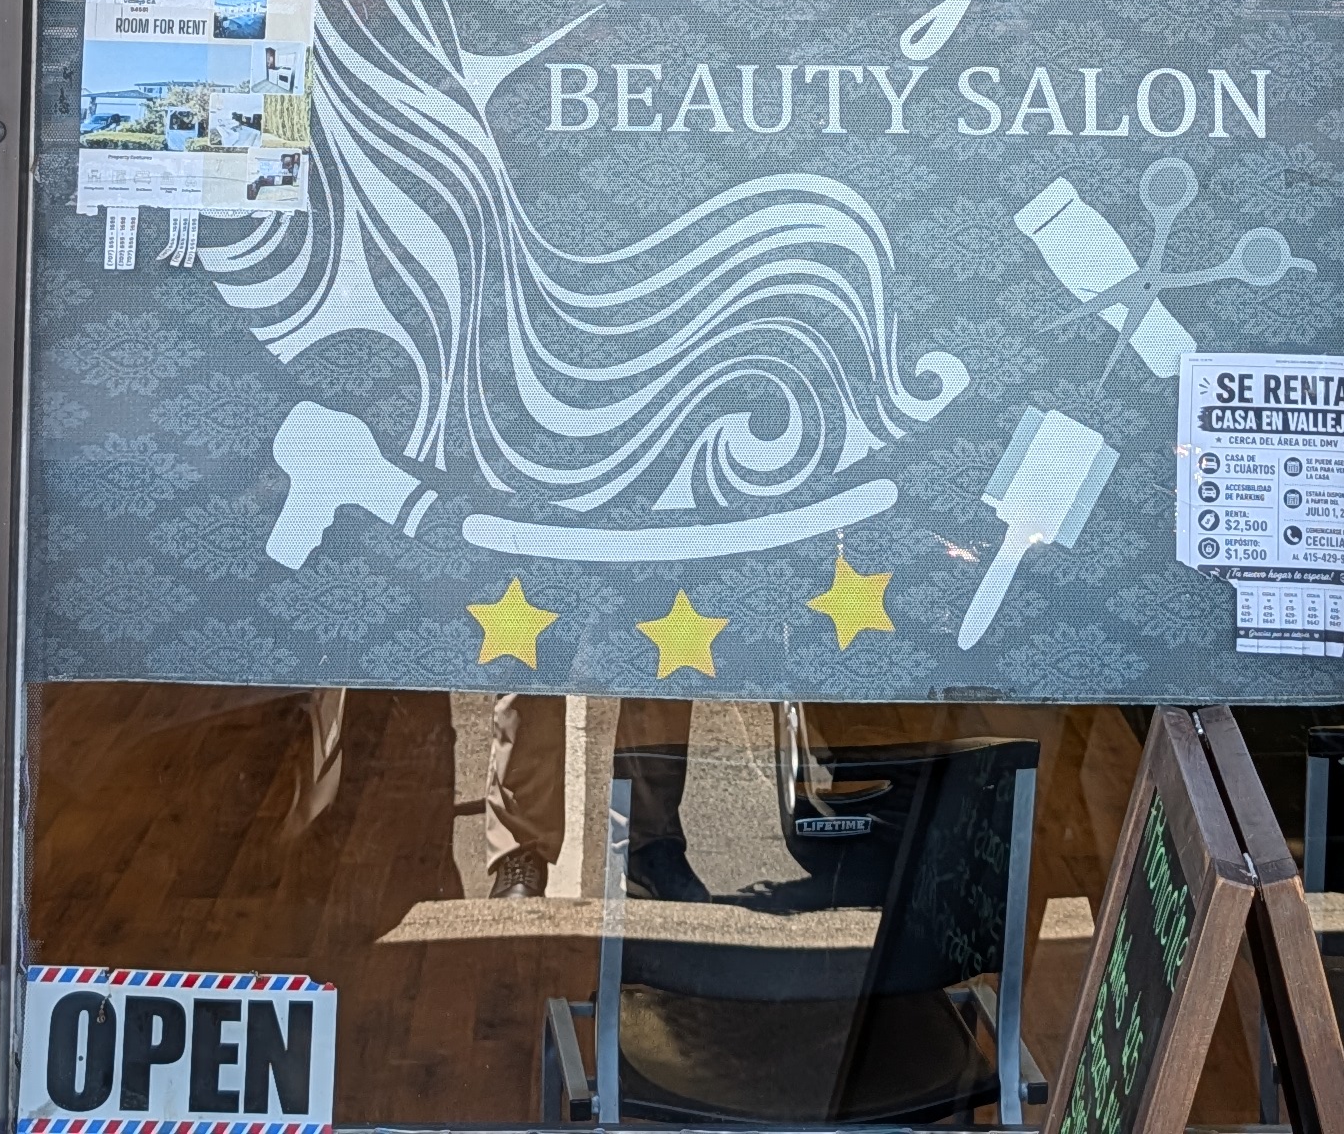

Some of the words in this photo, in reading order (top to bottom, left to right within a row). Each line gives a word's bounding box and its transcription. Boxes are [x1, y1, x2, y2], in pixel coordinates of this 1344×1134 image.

[115, 17, 149, 33] ROOM
[153, 18, 175, 34] FOR
[178, 19, 208, 35] RENT
[544, 62, 913, 136] BEAUTY
[956, 65, 1272, 140] SALON
[1215, 372, 1254, 404] SE
[1211, 408, 1258, 431] CASA
[1261, 410, 1283, 431] EN
[1228, 436, 1257, 446] CERCA
[1259, 437, 1275, 446] DEL
[1302, 438, 1318, 448] DEL
[1320, 439, 1339, 448] DMV
[1224, 453, 1244, 462] CASA
[1246, 454, 1256, 463] DE
[1224, 463, 1231, 473] 3
[1233, 463, 1276, 475] CUARTOS
[1305, 506, 1331, 518] JULIO
[1225, 518, 1268, 533] $2,500
[1225, 547, 1267, 561] $1,500
[803, 820, 865, 832] LIFETIME
[46, 990, 314, 1116] OPEN
